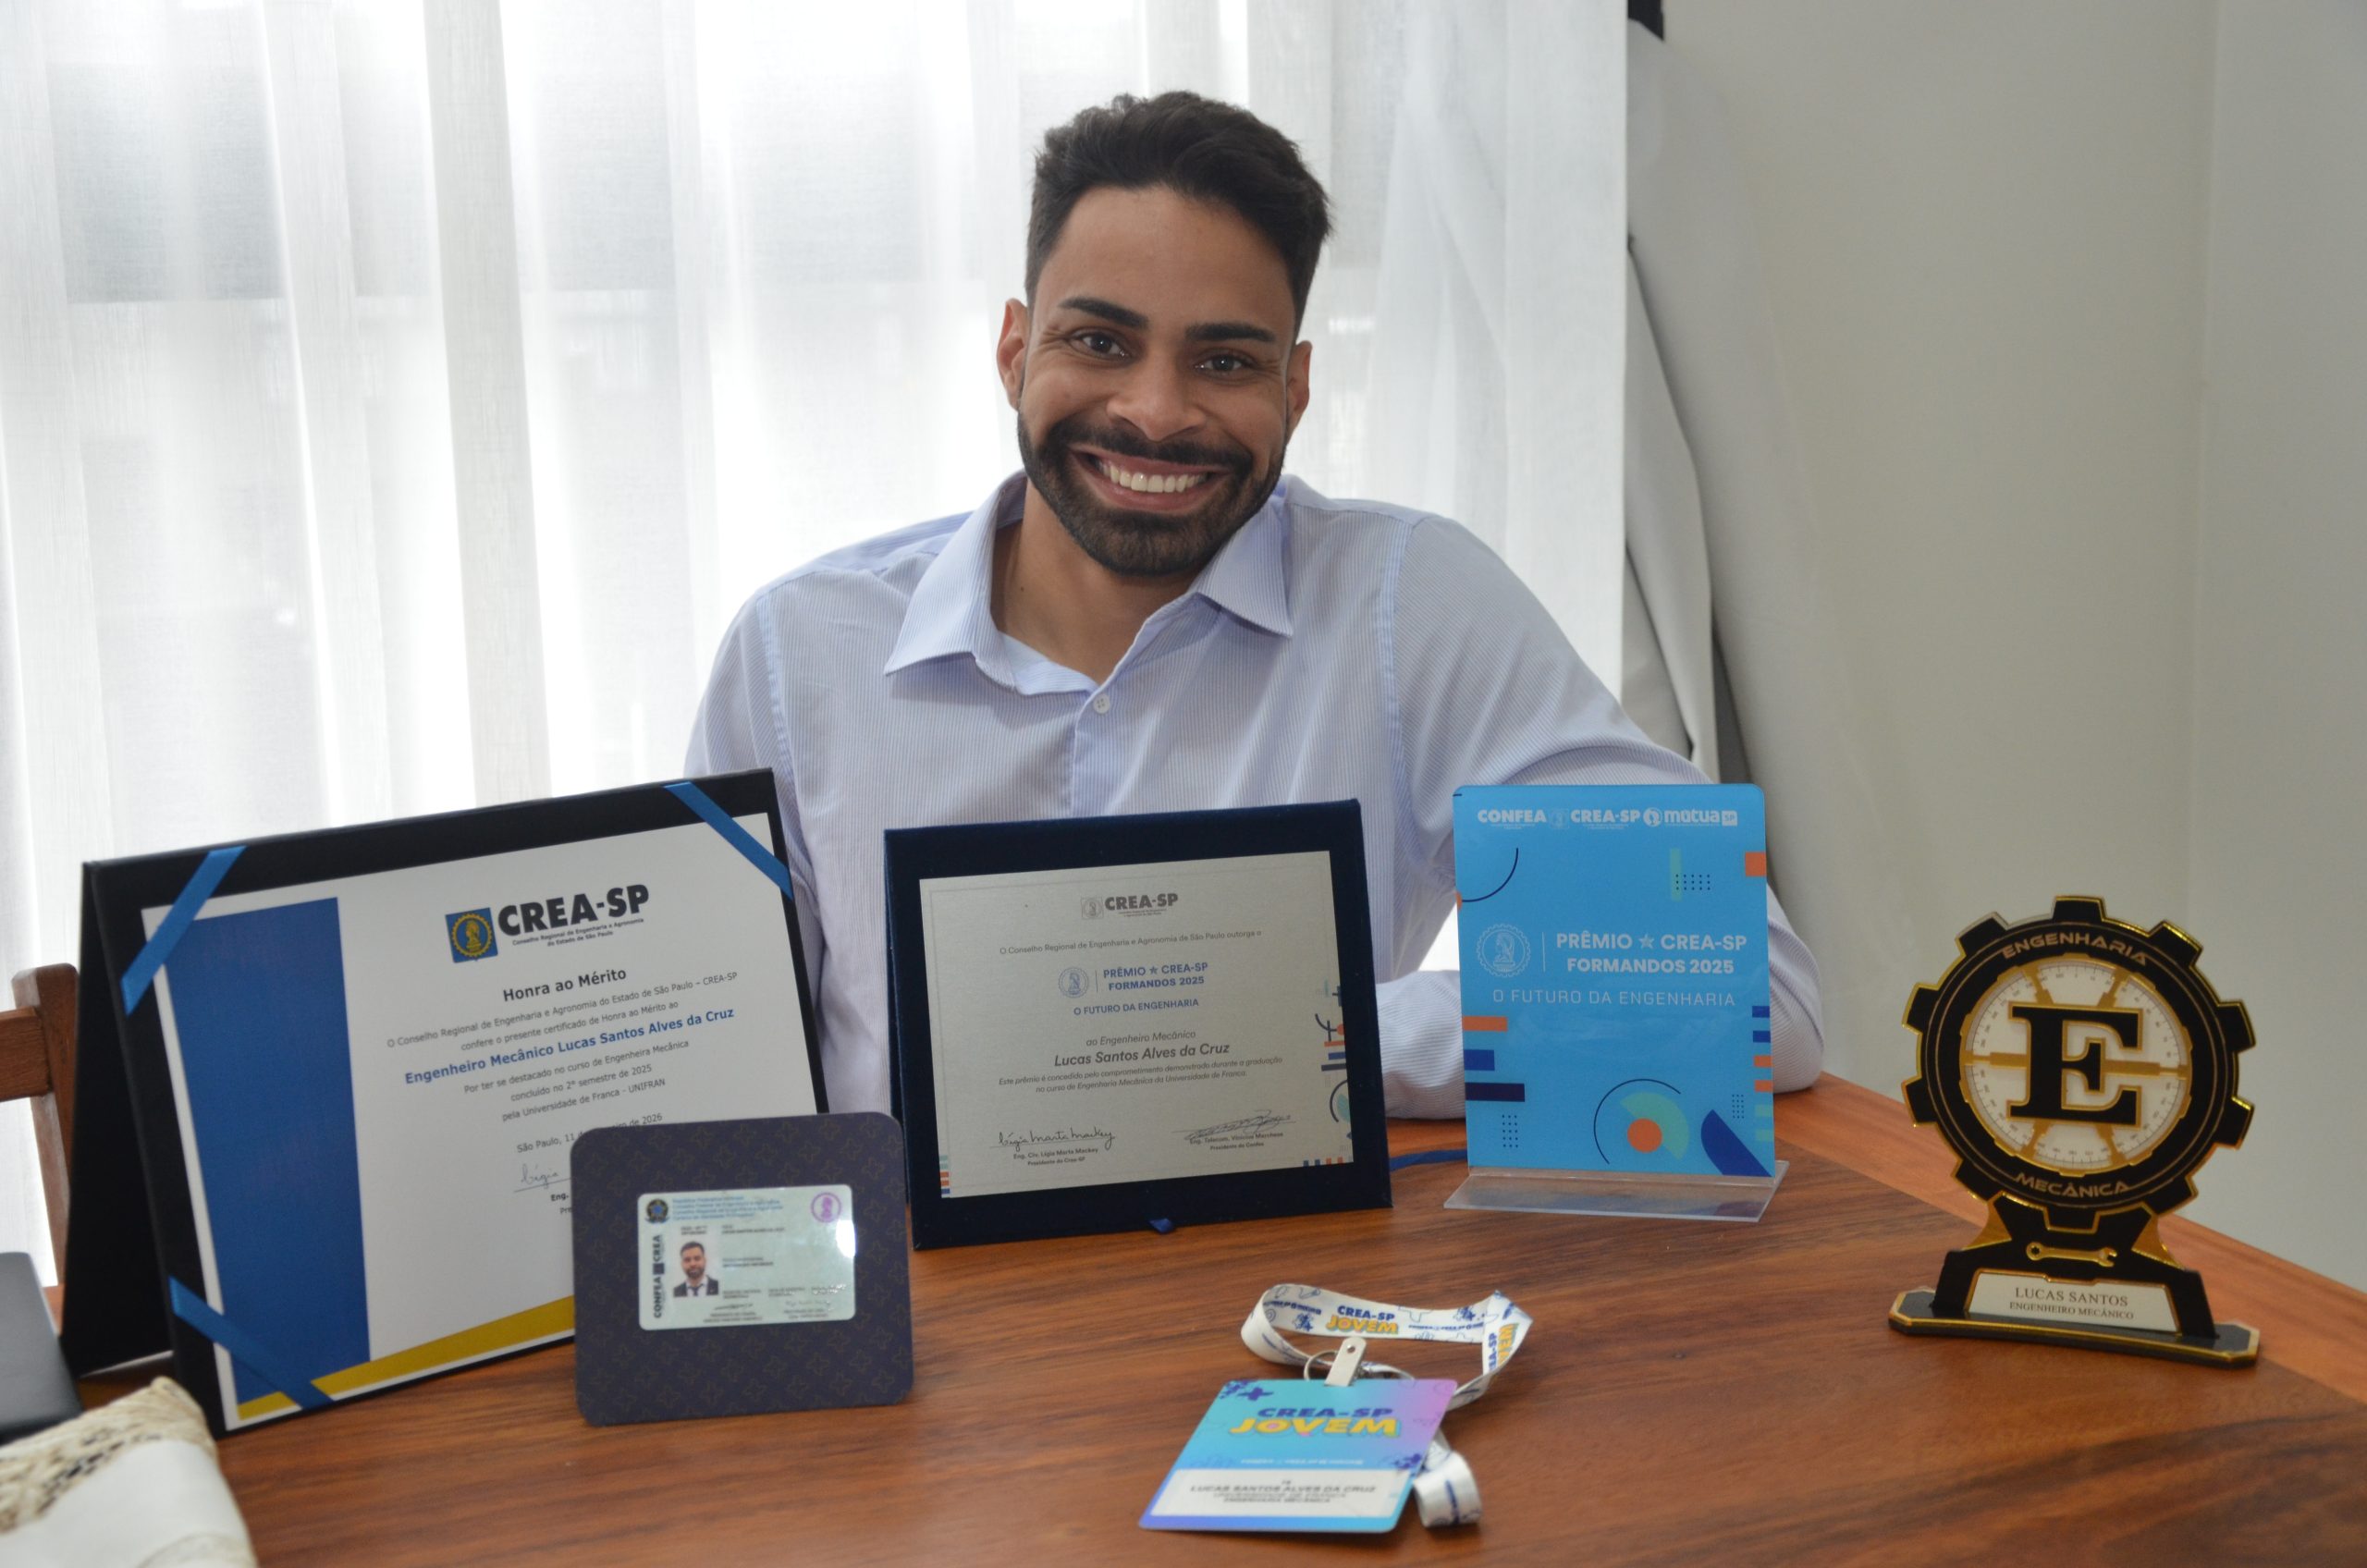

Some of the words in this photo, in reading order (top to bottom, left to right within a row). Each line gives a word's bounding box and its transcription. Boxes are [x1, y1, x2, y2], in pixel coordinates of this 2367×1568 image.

[1478, 809, 1546, 822] CONFEA
[1571, 809, 1640, 822] CREA-SP
[497, 884, 649, 937] CREA-SP
[1104, 892, 1178, 911] CREA-SP
[1008, 945, 1043, 954] Conselho
[1044, 941, 1076, 952] Regional
[1088, 938, 1130, 949] Engenharia
[1137, 934, 1177, 946] Agronomia
[1189, 933, 1204, 941] São
[1205, 931, 1225, 939] Paulo
[1226, 930, 1255, 938] outorga
[1556, 930, 1633, 949] PRÊMIO
[1660, 934, 1747, 950] CREA-SP
[2002, 932, 2147, 965] ENGENHARIA
[1103, 966, 1146, 978] PRÊMIO
[1160, 962, 1208, 974] CREA-SP
[1567, 958, 1686, 973] FORMANDOS
[1689, 959, 1734, 974] 2025
[502, 984, 550, 1001] Honra
[555, 979, 573, 992] ao
[577, 969, 626, 987] Mérito
[1108, 977, 1176, 991] FORMANDOS
[1179, 975, 1204, 986] 2025
[1073, 1007, 1081, 1015] O
[1083, 1004, 1121, 1014] FUTURO
[1122, 1003, 1135, 1011] DA
[1137, 998, 1198, 1011] ENGENHARIA
[1492, 988, 1503, 1002] O
[1511, 989, 1581, 1003] FUTURO
[1588, 990, 1612, 1004] DA
[1619, 991, 1735, 1006] ENGENHARIA
[386, 1038, 395, 1047] O
[396, 1031, 438, 1046] Conselho
[439, 1022, 479, 1037] Regional
[480, 1020, 492, 1029] de
[493, 1011, 542, 1027] Engenharia
[544, 1009, 550, 1017] e
[552, 999, 597, 1016] Agronomia
[598, 998, 609, 1006] do
[611, 991, 640, 1003] Estado
[641, 988, 652, 998] de
[653, 985, 669, 995] São
[670, 980, 693, 991] Paulo
[702, 971, 737, 986] CREA-SP
[460, 1038, 494, 1050] confere
[503, 1028, 541, 1043] presente
[543, 1019, 586, 1035] certificado
[588, 1016, 599, 1025] de
[601, 1011, 627, 1022] Honra
[628, 1009, 639, 1017] ao
[640, 1003, 666, 1014] Mérito
[668, 1001, 679, 1010] ao
[404, 1060, 486, 1084] Engenheiro
[489, 1046, 554, 1067] Mecânico
[557, 1036, 596, 1052] Lucas
[599, 1027, 644, 1044] Santos
[648, 1019, 683, 1034] Alves
[686, 1013, 702, 1026] da
[705, 1009, 734, 1022] Cruz
[1085, 1038, 1098, 1047] ao
[1099, 1033, 1149, 1047] Engenheiro
[1151, 1029, 1196, 1041] Mecânico
[1054, 1054, 1091, 1067] Lucas
[1094, 1050, 1138, 1063] Santos
[1141, 1047, 1176, 1060] Alves
[1179, 1044, 1196, 1057] da
[1199, 1042, 1230, 1055] Cruz
[2007, 1002, 2142, 1127] E
[463, 1084, 479, 1094] Por
[480, 1081, 494, 1090] ter
[496, 1079, 507, 1087] se
[508, 1068, 552, 1084] destacado
[554, 1066, 566, 1074] no
[567, 1060, 590, 1072] curso
[592, 1058, 603, 1067] de
[604, 1048, 651, 1064] Engenheira
[652, 1040, 689, 1054] Mecânica
[510, 1086, 550, 1101] concluído
[552, 1084, 564, 1092] no
[577, 1072, 617, 1087] semestre
[618, 1069, 629, 1078] de
[631, 1063, 652, 1075] 2025
[501, 1110, 521, 1122] pela
[521, 1097, 577, 1116] Universidade
[579, 1095, 590, 1104] de
[591, 1088, 620, 1100] Franca
[628, 1078, 666, 1093] UNIFRAN
[642, 1112, 663, 1124] 2026
[517, 1144, 533, 1153] São
[535, 1138, 561, 1148] Paulo,
[565, 1133, 574, 1143] 11
[2016, 1172, 2129, 1197] MECÂNICA
[550, 1193, 570, 1202] Eng.
[2015, 1287, 2064, 1301] LUCAS
[2068, 1291, 2128, 1306] SANTOS
[1337, 1305, 1395, 1321] CREA-SP
[2009, 1302, 2076, 1316] ENGENHEIRO
[2078, 1306, 2134, 1320] MECÂNICO
[1326, 1314, 1398, 1334] JOVEM
[1257, 1408, 1393, 1417] CREA-SP
[1230, 1418, 1401, 1438] JOVEM
